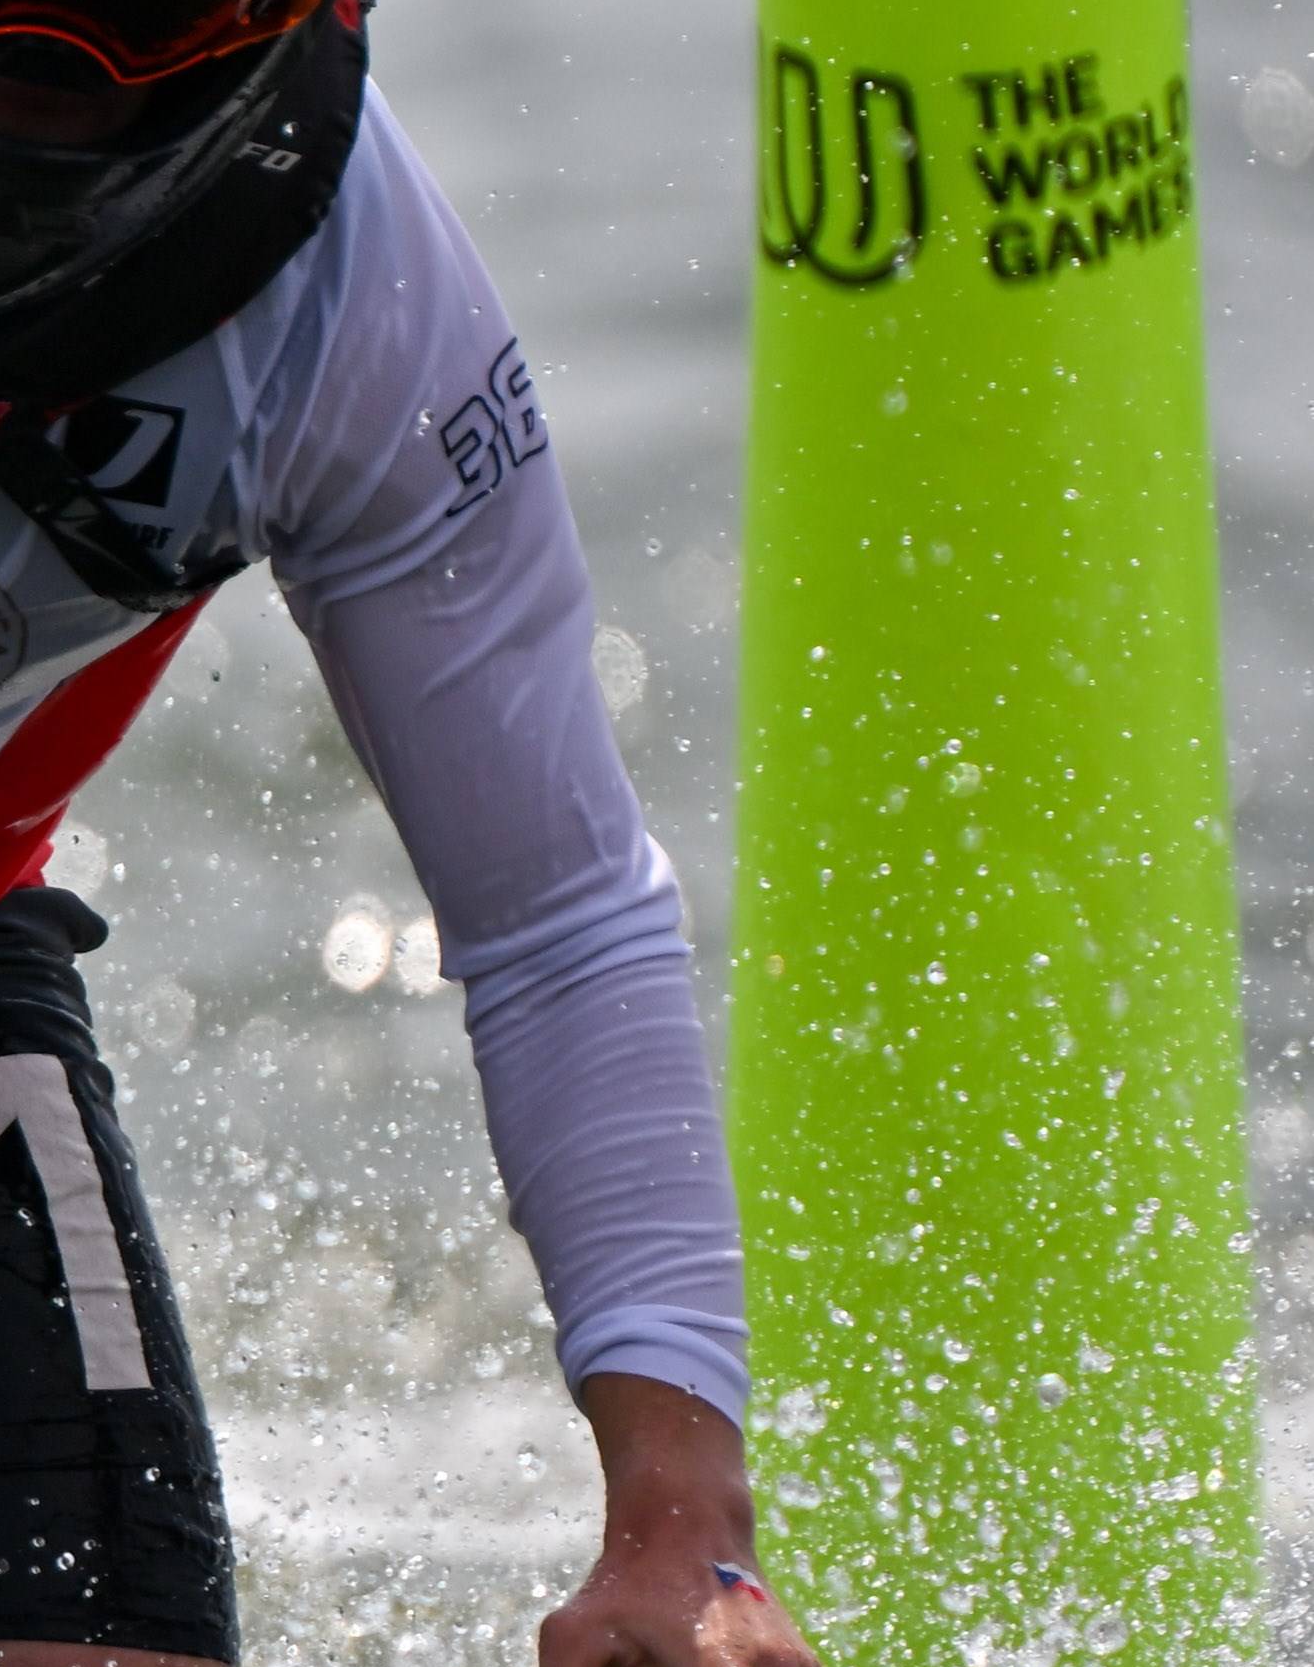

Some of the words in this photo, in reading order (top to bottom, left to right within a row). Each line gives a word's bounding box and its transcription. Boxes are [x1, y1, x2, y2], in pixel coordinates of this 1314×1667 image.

[963, 50, 1105, 132] THE
[234, 140, 303, 172] FO
[974, 74, 1188, 204] WORLD
